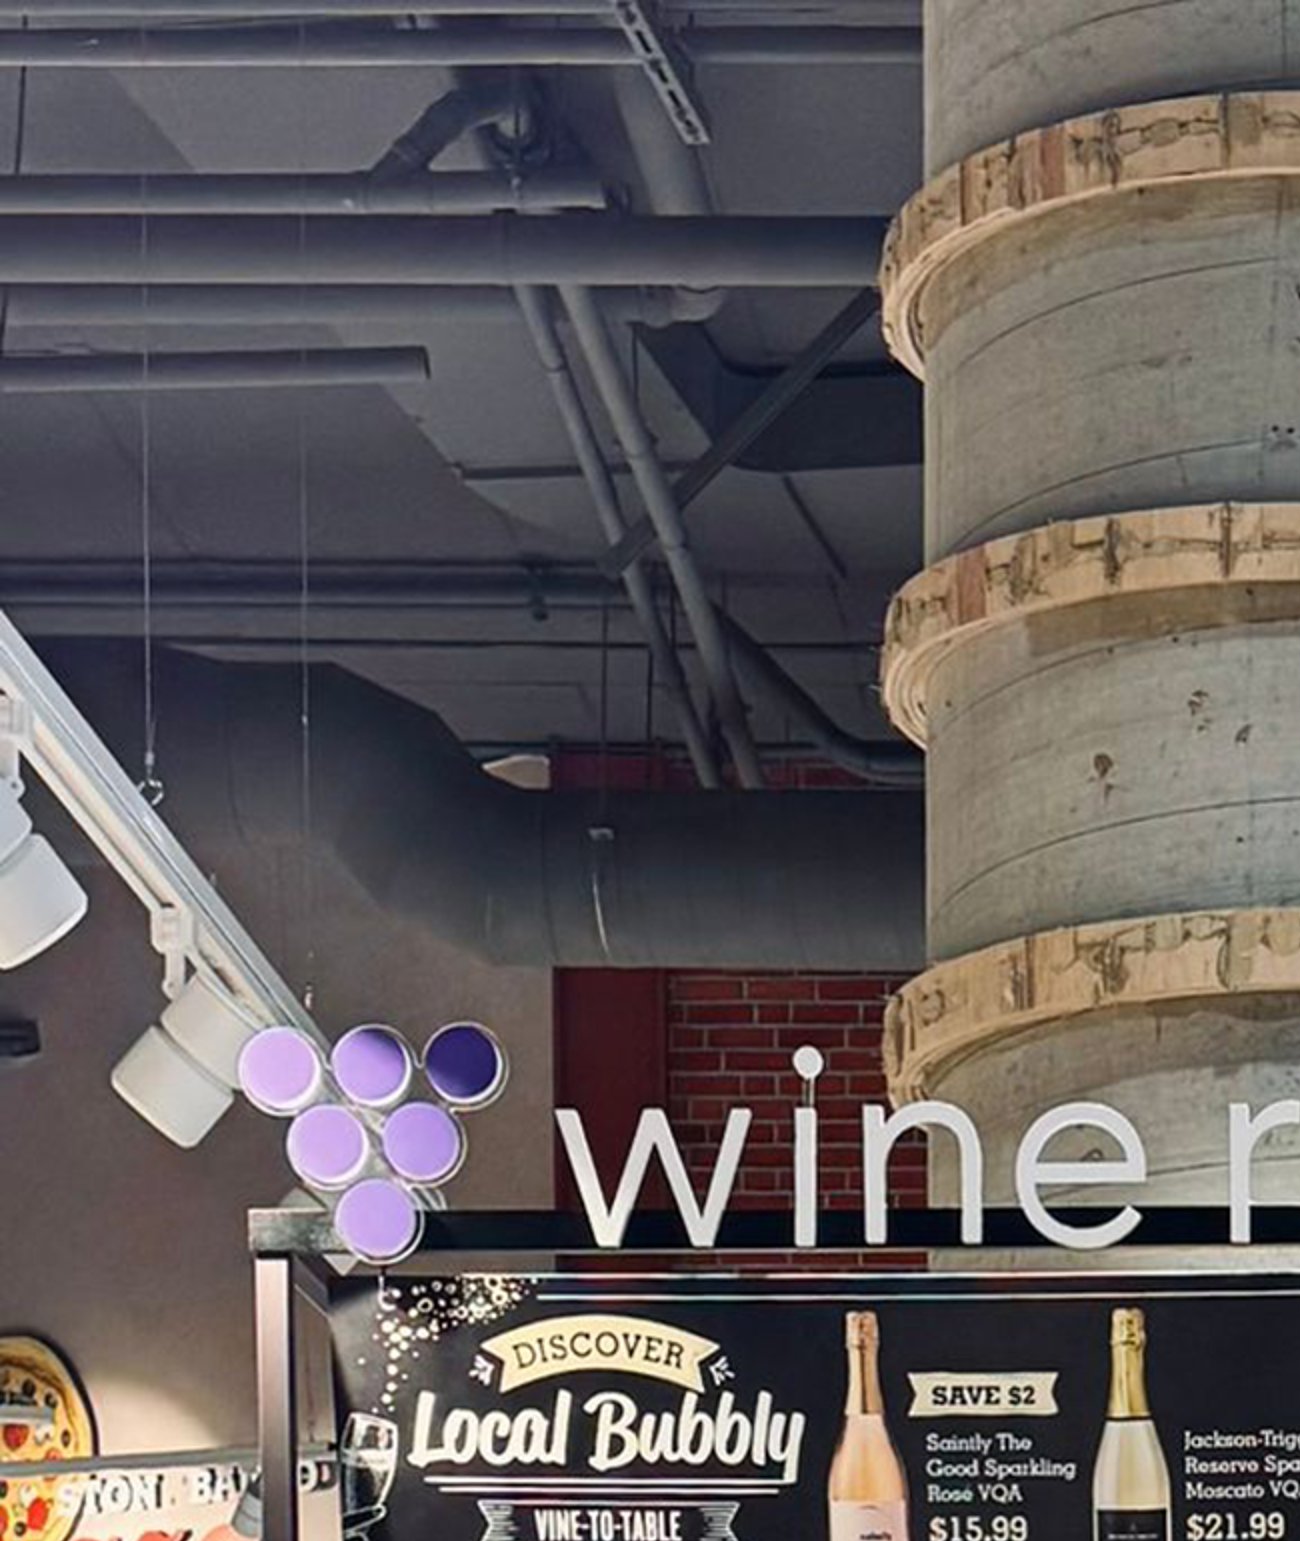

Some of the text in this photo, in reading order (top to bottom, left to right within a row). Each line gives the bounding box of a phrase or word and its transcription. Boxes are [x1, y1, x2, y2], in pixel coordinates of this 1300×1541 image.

[554, 1045, 1121, 1250] wine
[511, 1331, 687, 1372] DISCOVER
[931, 1384, 1036, 1408] SAVE $2
[406, 1388, 806, 1484] Local Bubbly
[925, 1433, 1033, 1456] Saintly The
[925, 1457, 1077, 1484] Good Sparkling
[1184, 1457, 1259, 1475] Reserve
[977, 1484, 1024, 1504] VQA
[1185, 1480, 1265, 1500] Moscato
